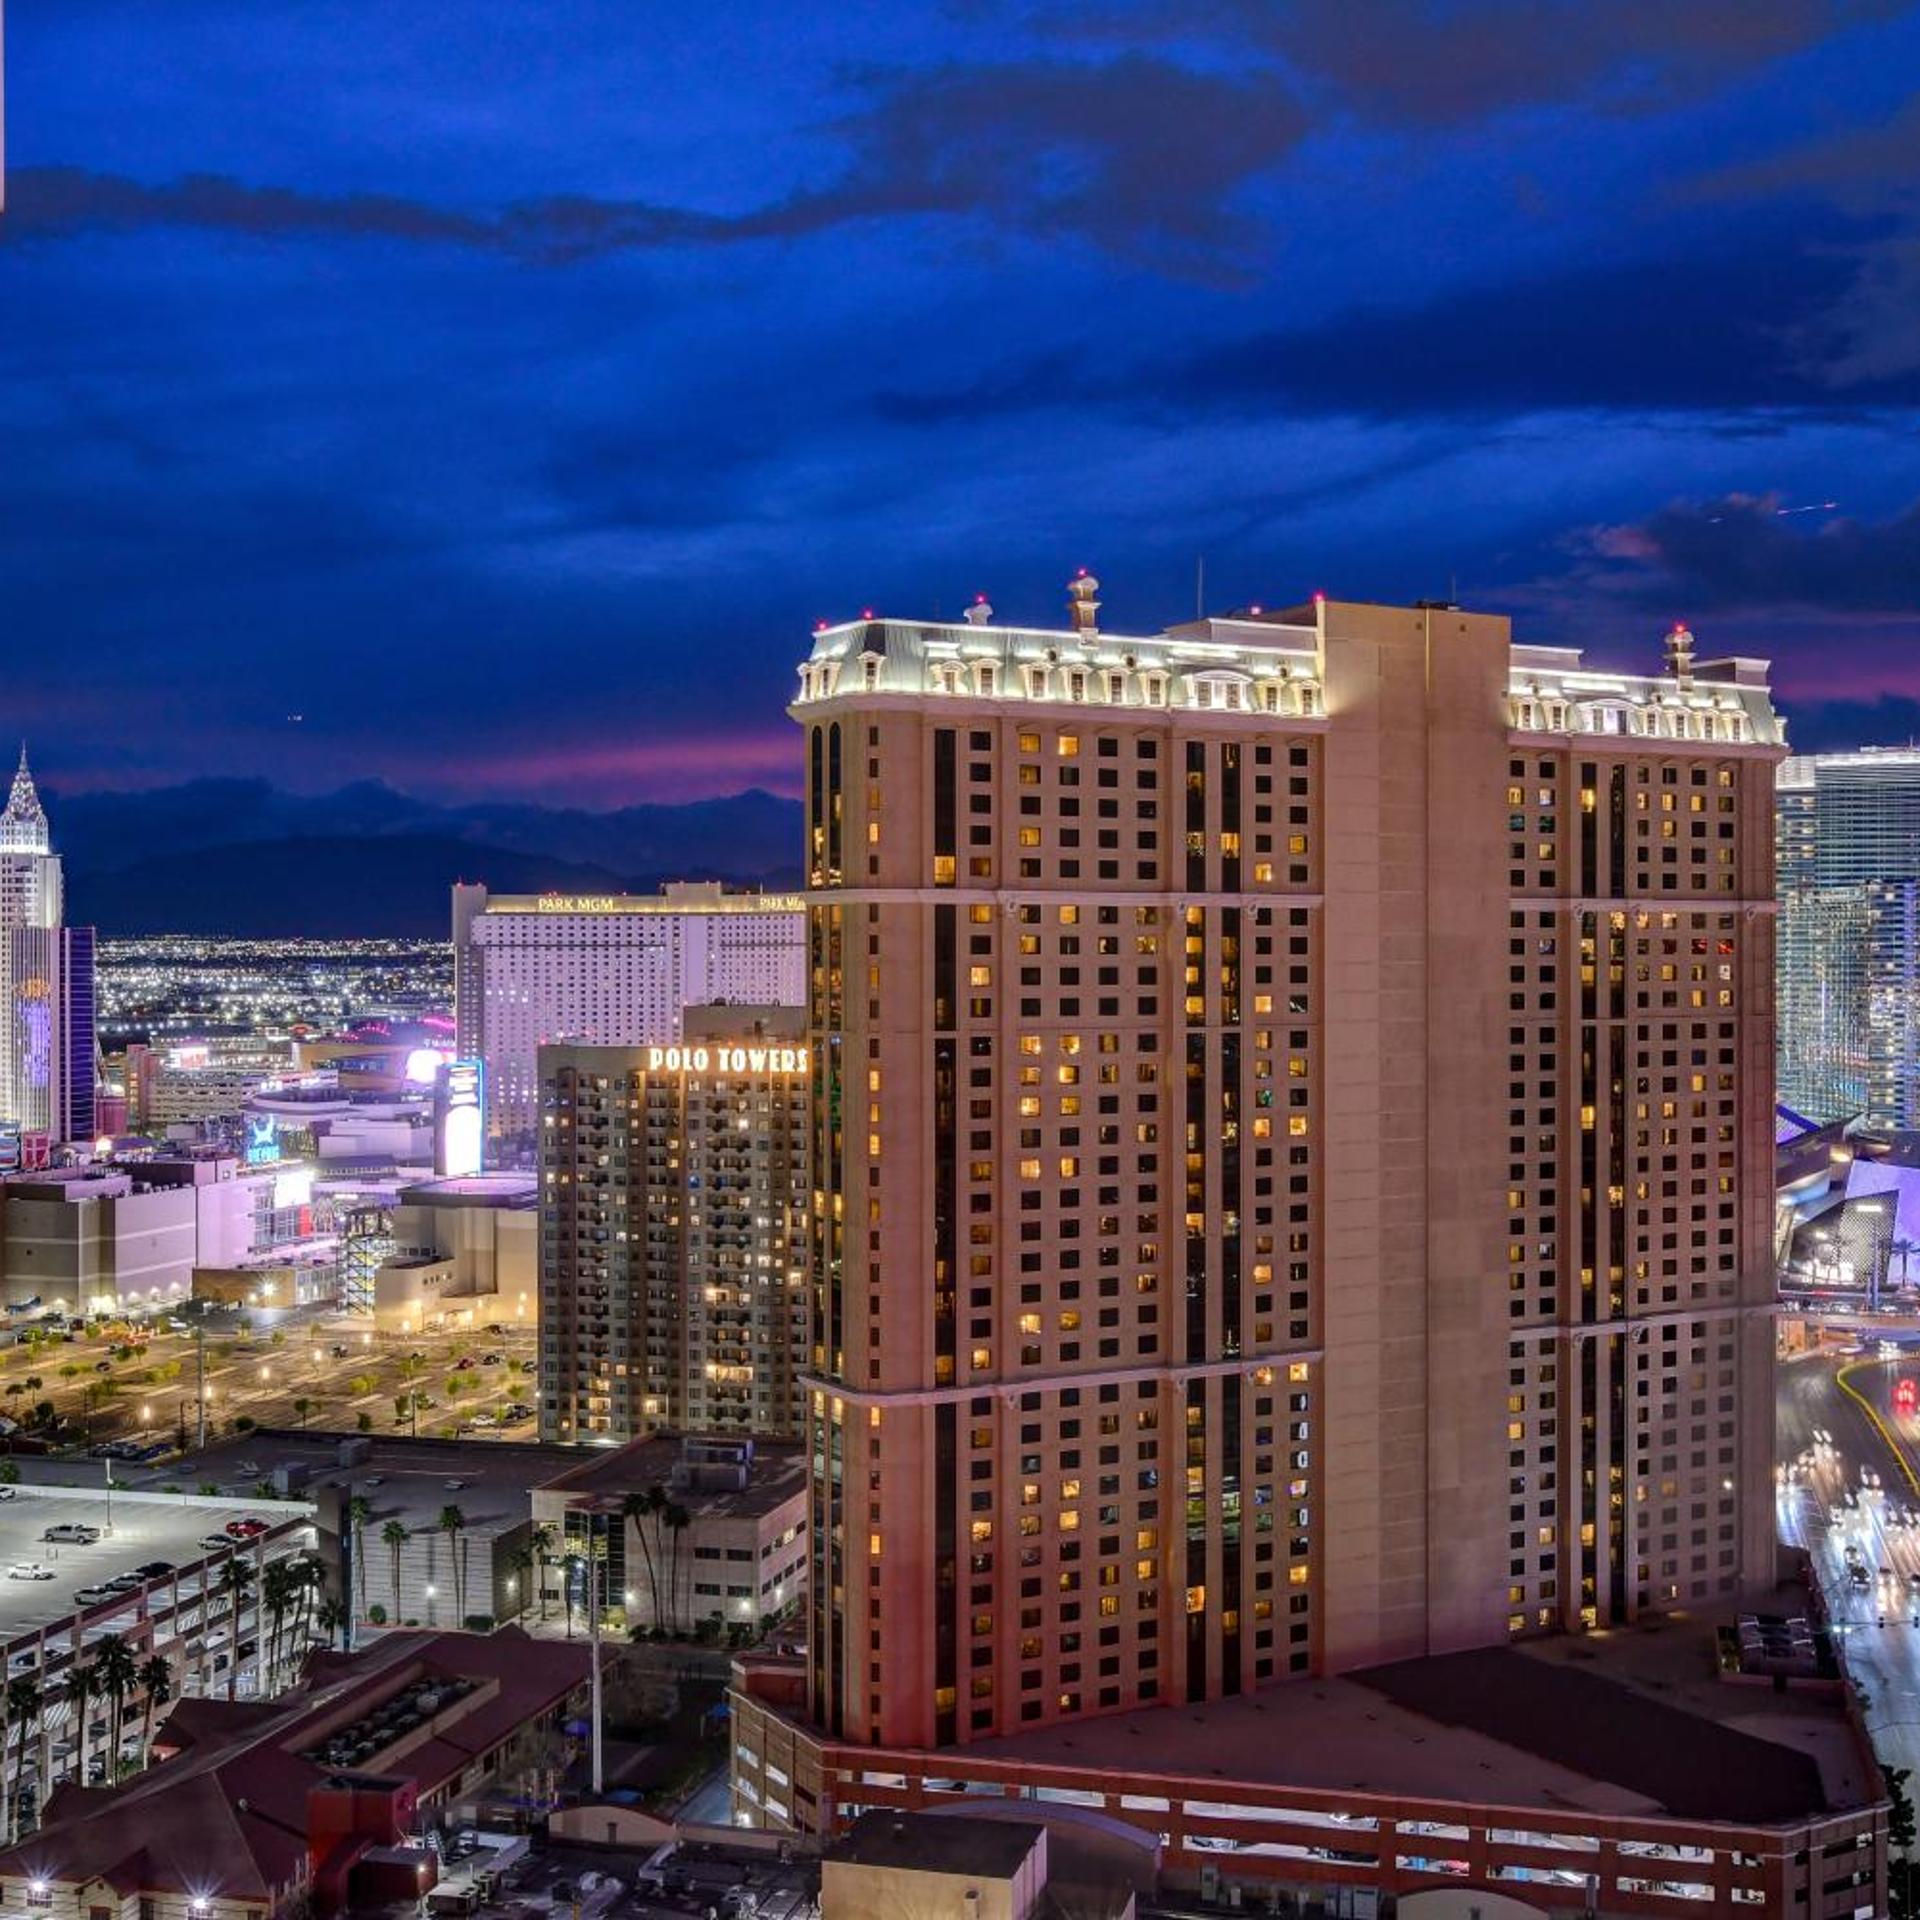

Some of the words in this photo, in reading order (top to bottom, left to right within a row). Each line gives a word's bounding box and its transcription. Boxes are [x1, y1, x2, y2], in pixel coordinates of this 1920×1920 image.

[539, 898, 573, 911] PARK
[578, 898, 613, 911] MGM
[650, 1048, 709, 1071] POLO
[718, 1048, 808, 1073] TOWERS
